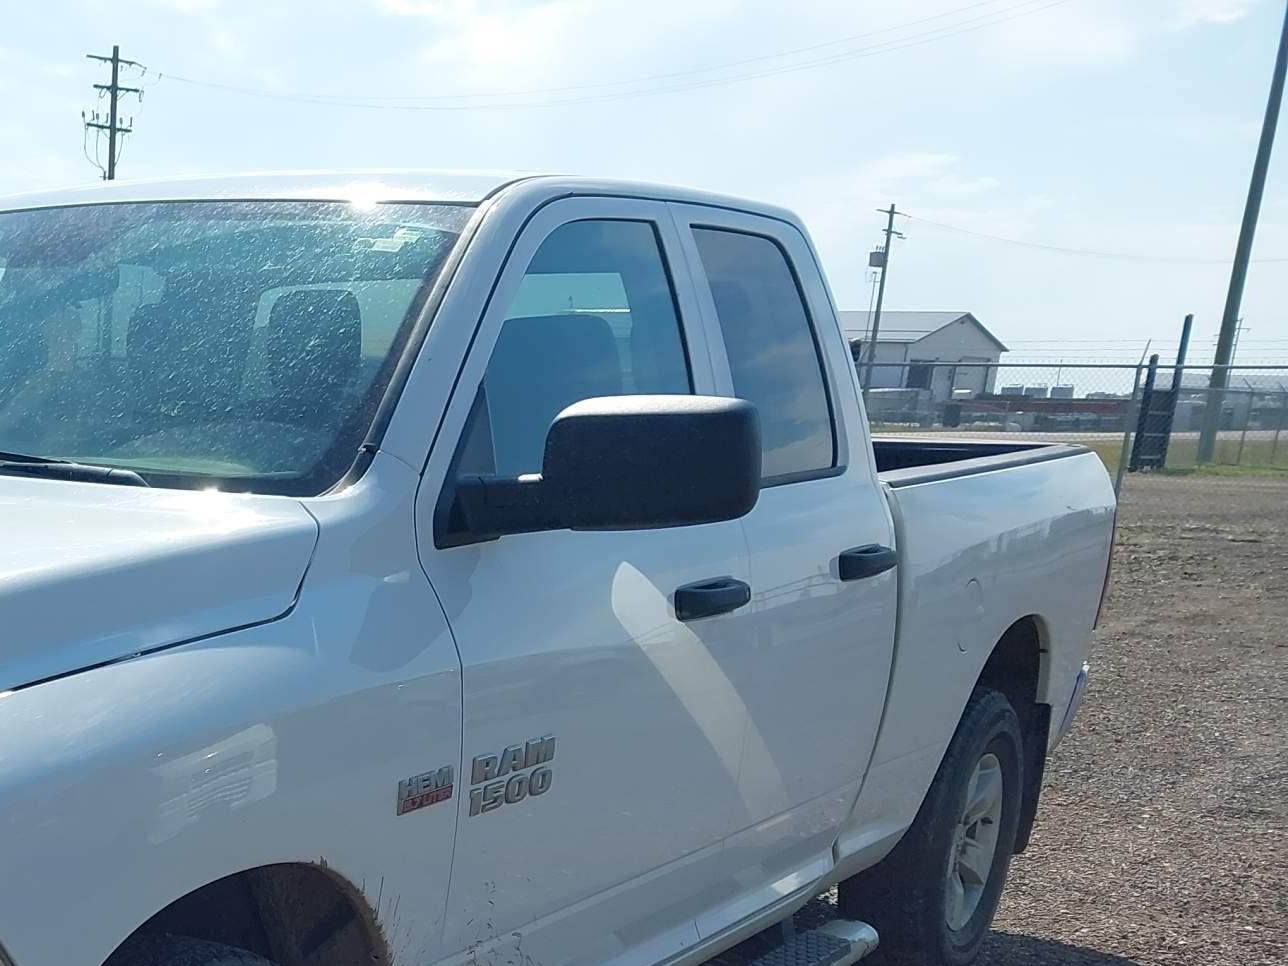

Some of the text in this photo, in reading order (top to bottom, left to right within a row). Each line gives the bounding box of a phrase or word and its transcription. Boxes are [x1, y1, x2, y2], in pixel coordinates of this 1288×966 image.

[398, 765, 454, 804] HEMI
[471, 733, 556, 785] RAM
[469, 766, 553, 817] 1500
